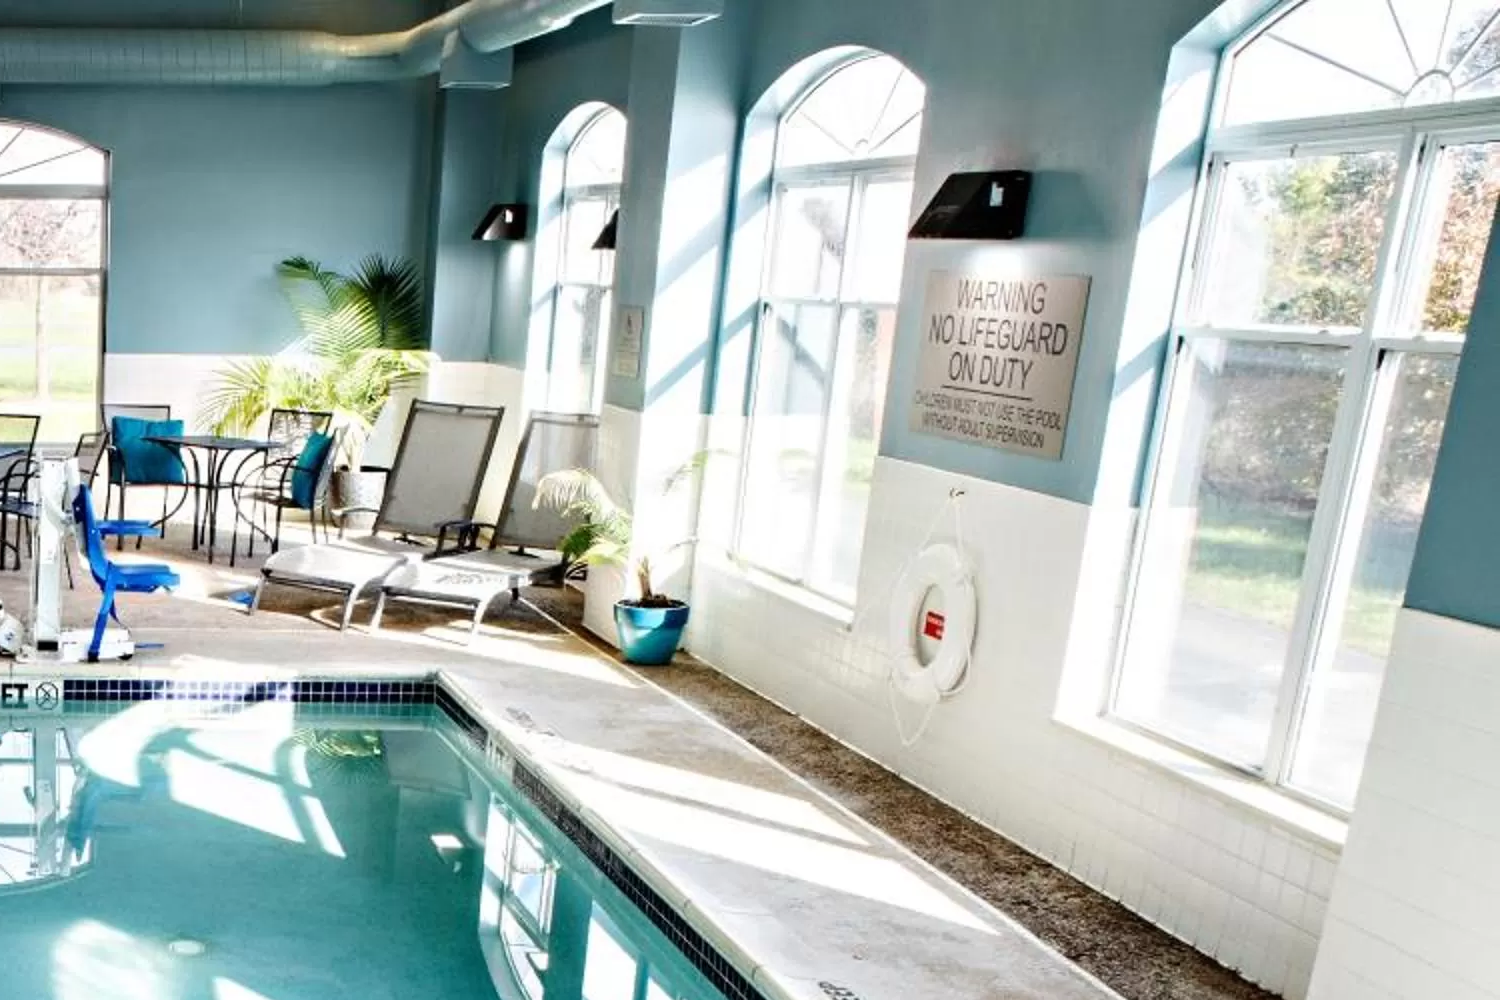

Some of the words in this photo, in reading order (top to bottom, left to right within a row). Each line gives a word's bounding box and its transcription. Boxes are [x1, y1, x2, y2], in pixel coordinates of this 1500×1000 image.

[957, 279, 1047, 314] WARNING
[928, 314, 955, 345] NO
[958, 316, 1068, 355] LIFEGUARD
[949, 351, 977, 383] ON
[979, 356, 1034, 390] DUTY
